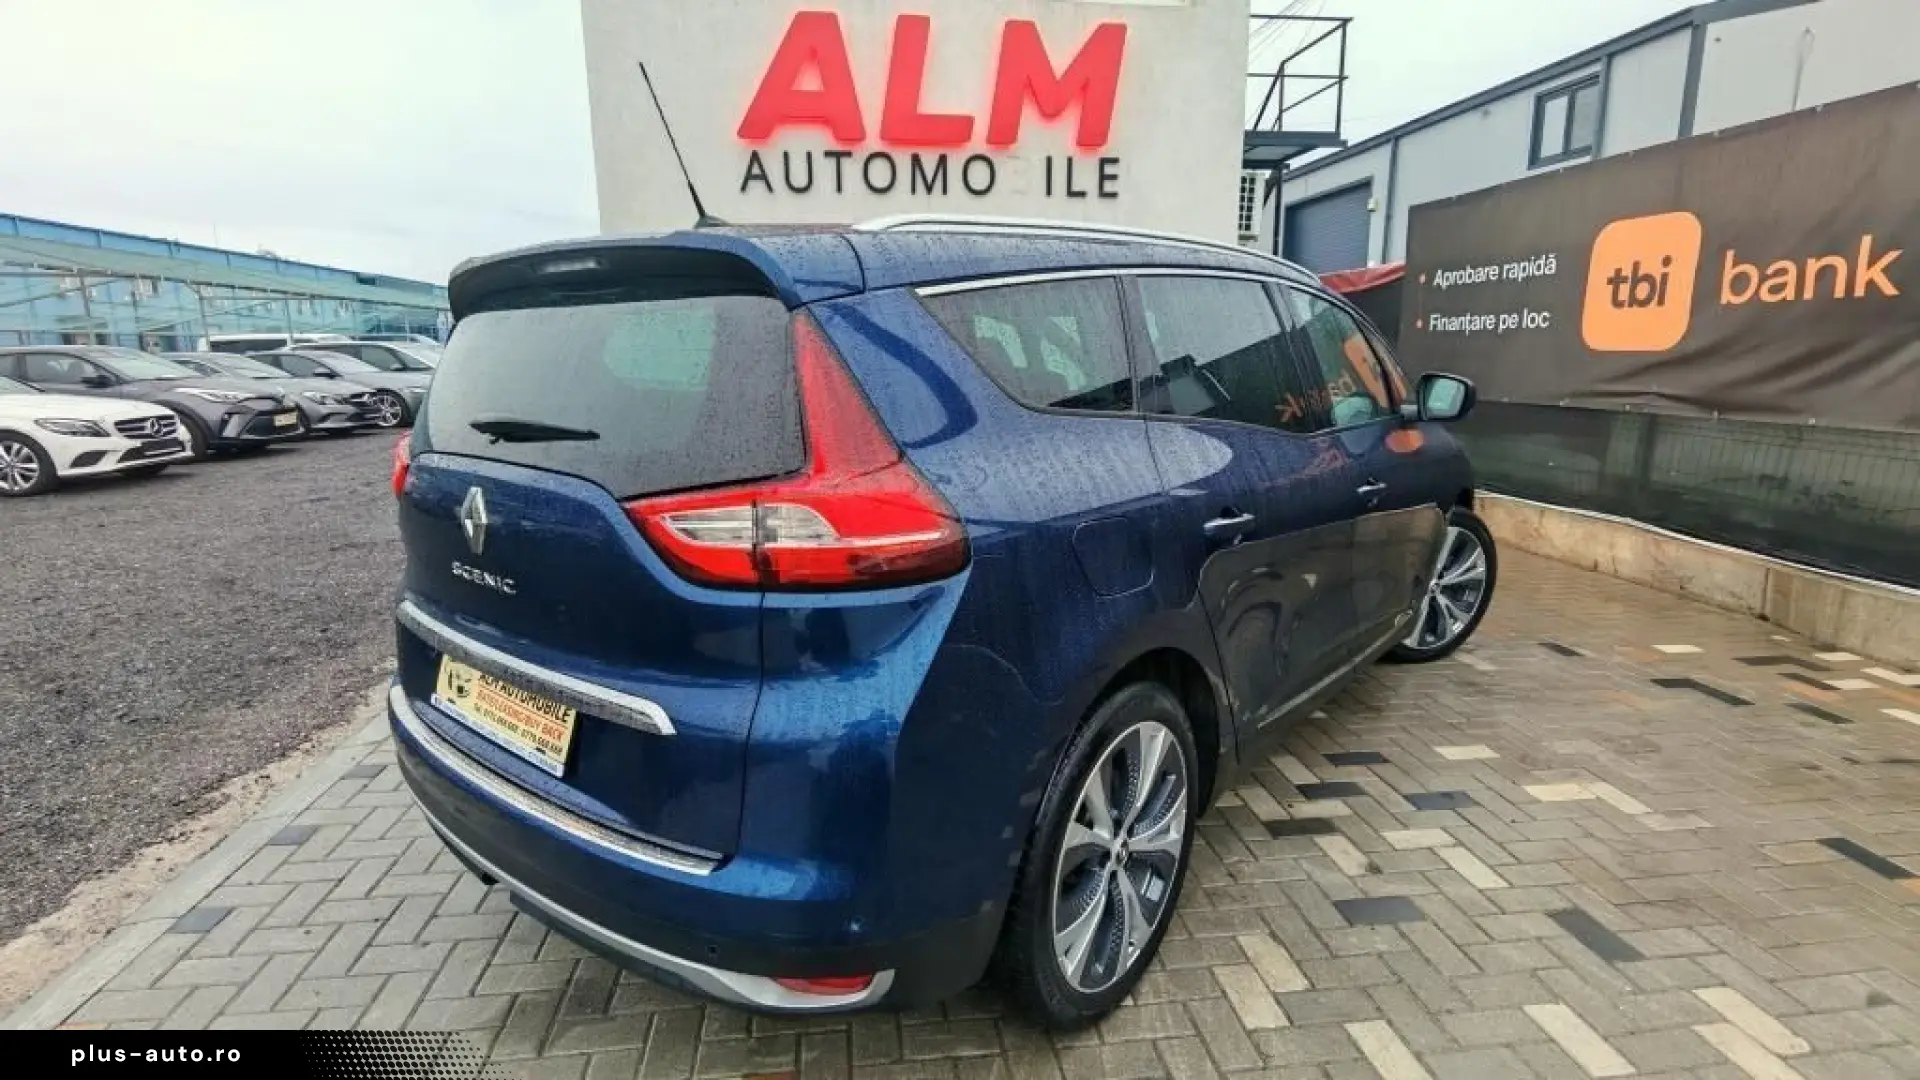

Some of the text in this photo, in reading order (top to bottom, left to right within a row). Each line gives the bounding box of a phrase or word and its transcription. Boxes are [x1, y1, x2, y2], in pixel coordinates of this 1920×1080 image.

[737, 11, 1127, 146] ALM
[740, 150, 1120, 198] AUTOMOILE
[1433, 252, 1557, 290] Aprobare rapidă
[1606, 234, 1903, 310] tbi bank
[1498, 312, 1520, 335] pe
[1522, 307, 1551, 329] loc
[451, 561, 517, 596] SCENIC
